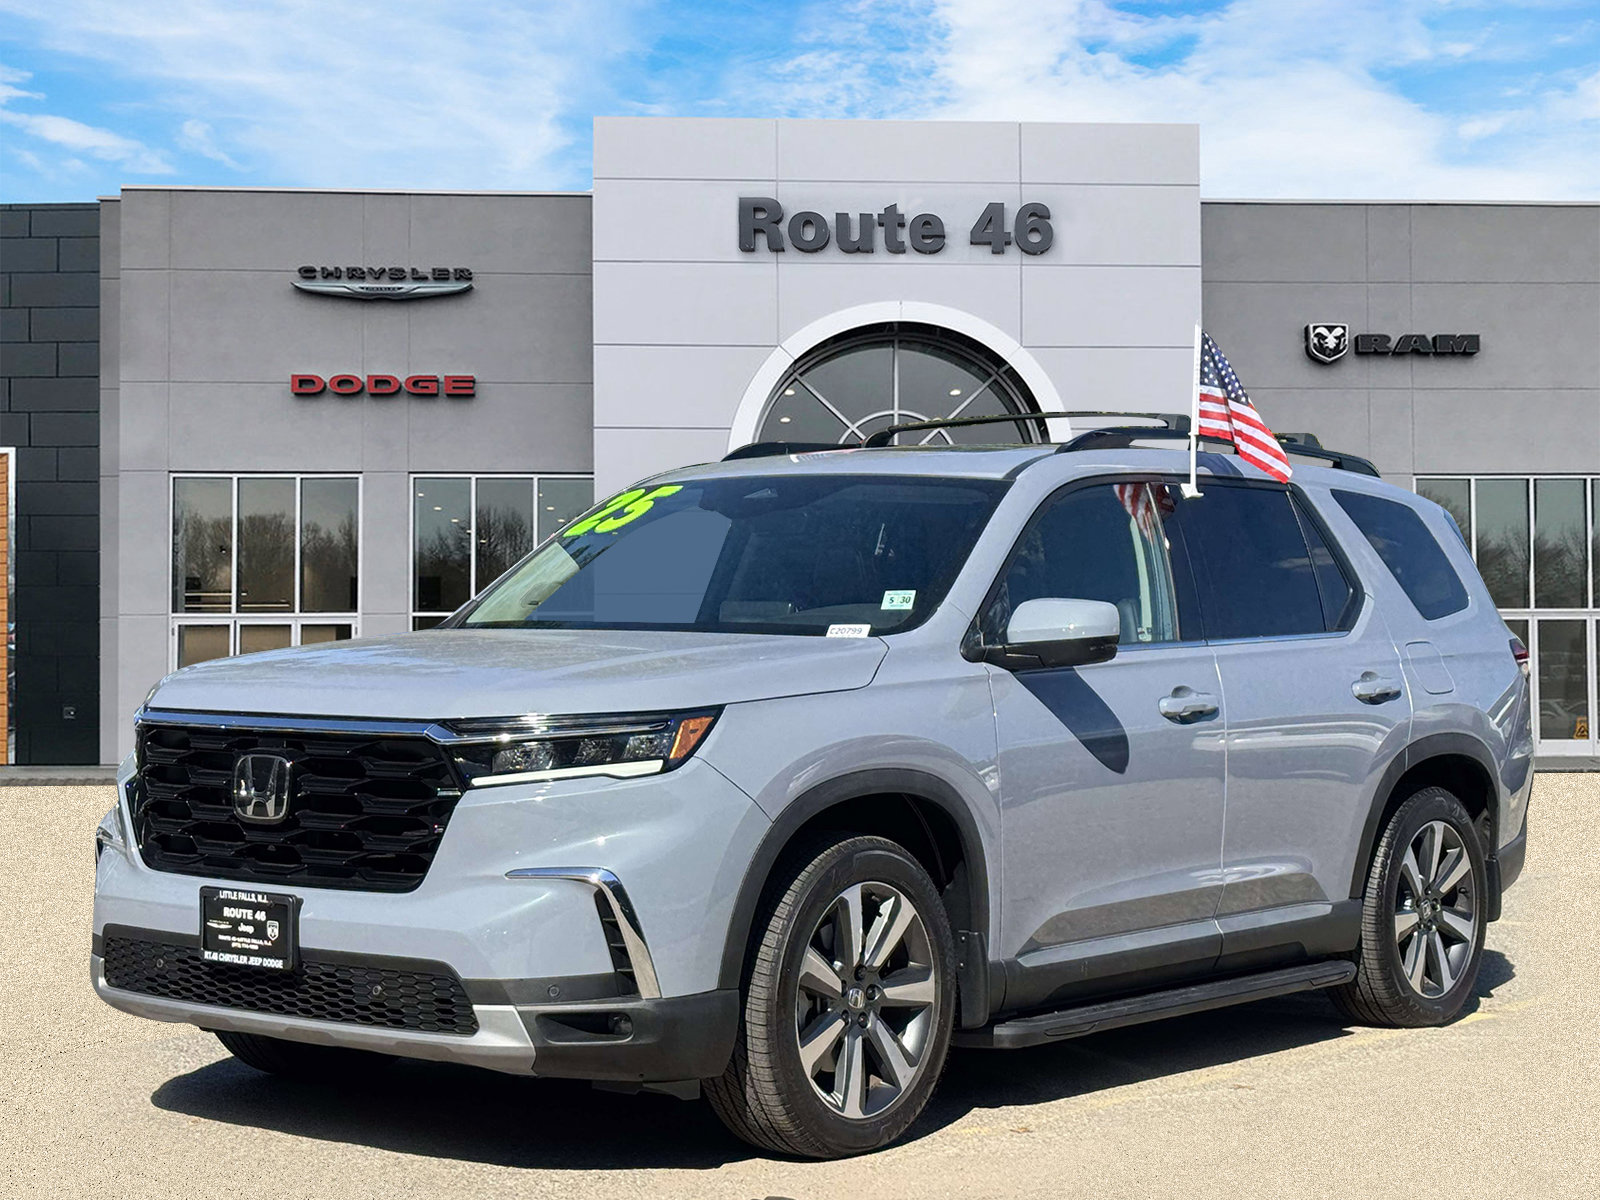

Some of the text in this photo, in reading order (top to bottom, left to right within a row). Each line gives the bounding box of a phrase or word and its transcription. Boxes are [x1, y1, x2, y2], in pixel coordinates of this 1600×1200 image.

[738, 197, 1053, 255] Route 46
[298, 266, 473, 281] CHRYSLER
[1354, 333, 1481, 356] RAM
[291, 374, 476, 397] DODGE
[829, 627, 863, 635] C20799
[219, 890, 238, 900] LITTLE
[223, 906, 267, 921] ROUTE 46
[238, 922, 255, 934] Jeep
[219, 952, 248, 964] CHRYSLER
[248, 956, 262, 966] JEEP
[263, 958, 284, 969] DODGE
